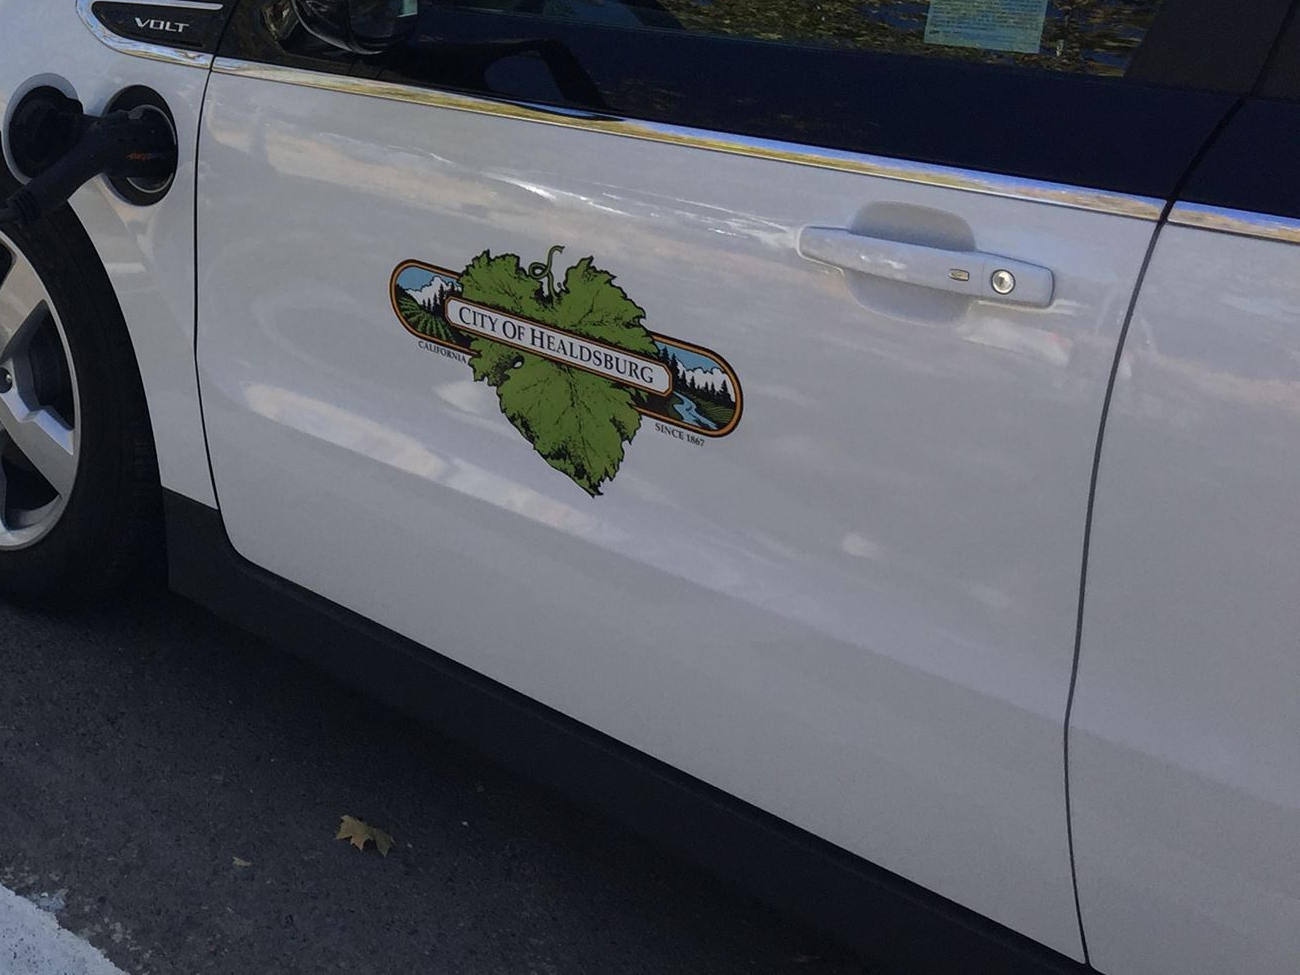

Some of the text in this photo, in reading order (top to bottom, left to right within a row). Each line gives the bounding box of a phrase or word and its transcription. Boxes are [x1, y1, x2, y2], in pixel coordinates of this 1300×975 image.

[134, 17, 191, 33] VOLT
[418, 340, 467, 364] CALIFORNIA
[458, 305, 654, 385] CITY OF HEALDSBURG
[654, 422, 705, 447] SINCE 1867
